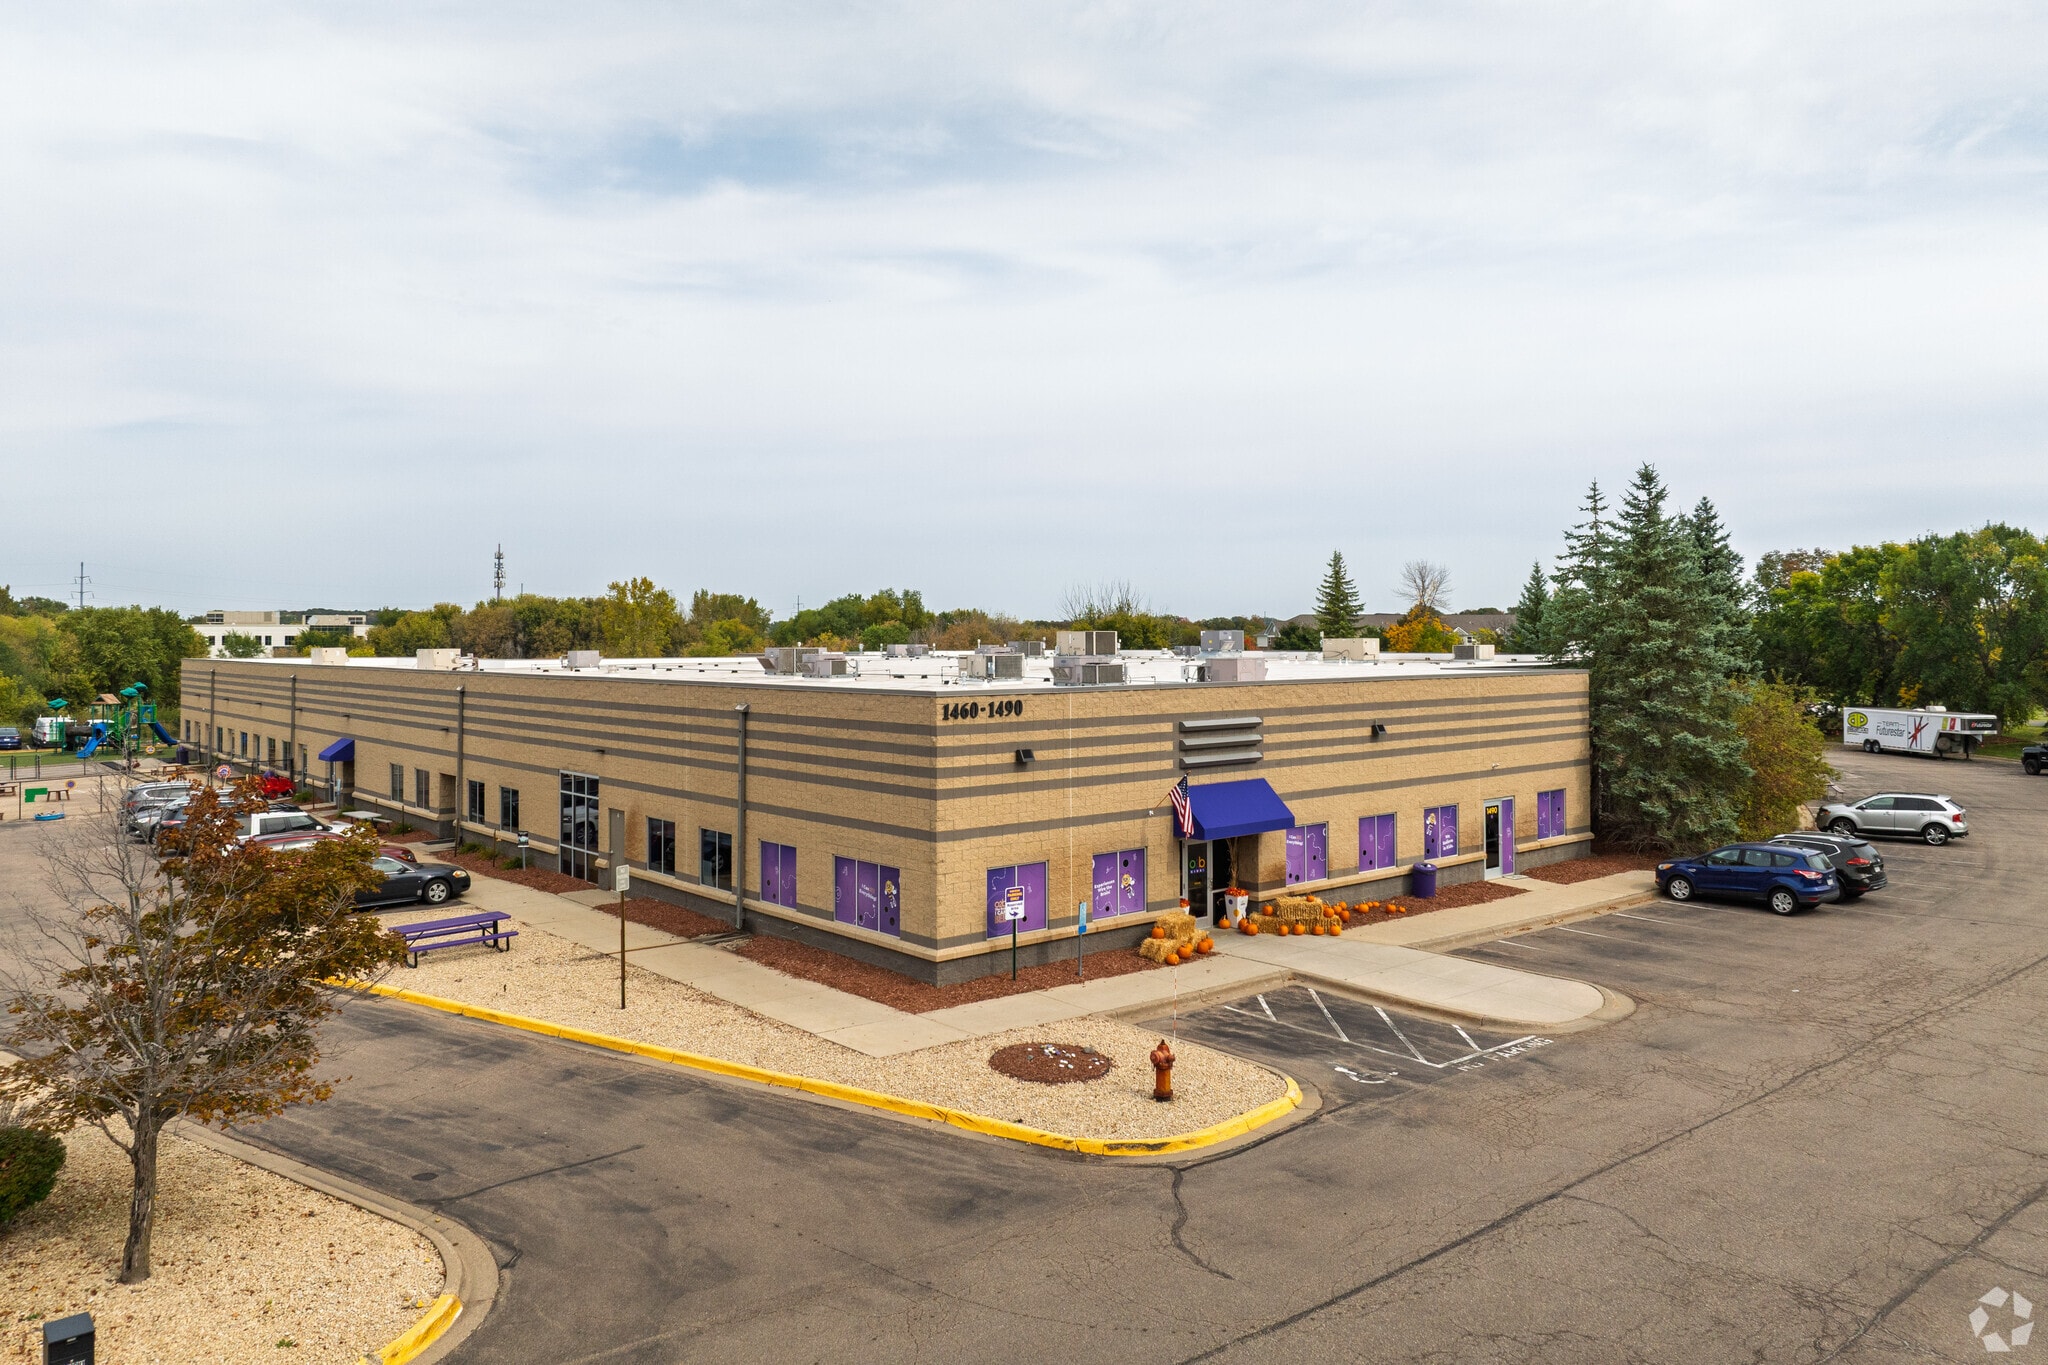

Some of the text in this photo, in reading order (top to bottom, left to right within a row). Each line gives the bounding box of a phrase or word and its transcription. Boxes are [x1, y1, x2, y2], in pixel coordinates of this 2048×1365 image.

[942, 700, 1023, 720] 1460-1490
[1876, 725, 1905, 737] Futurestar
[1486, 807, 1497, 815] 1490
